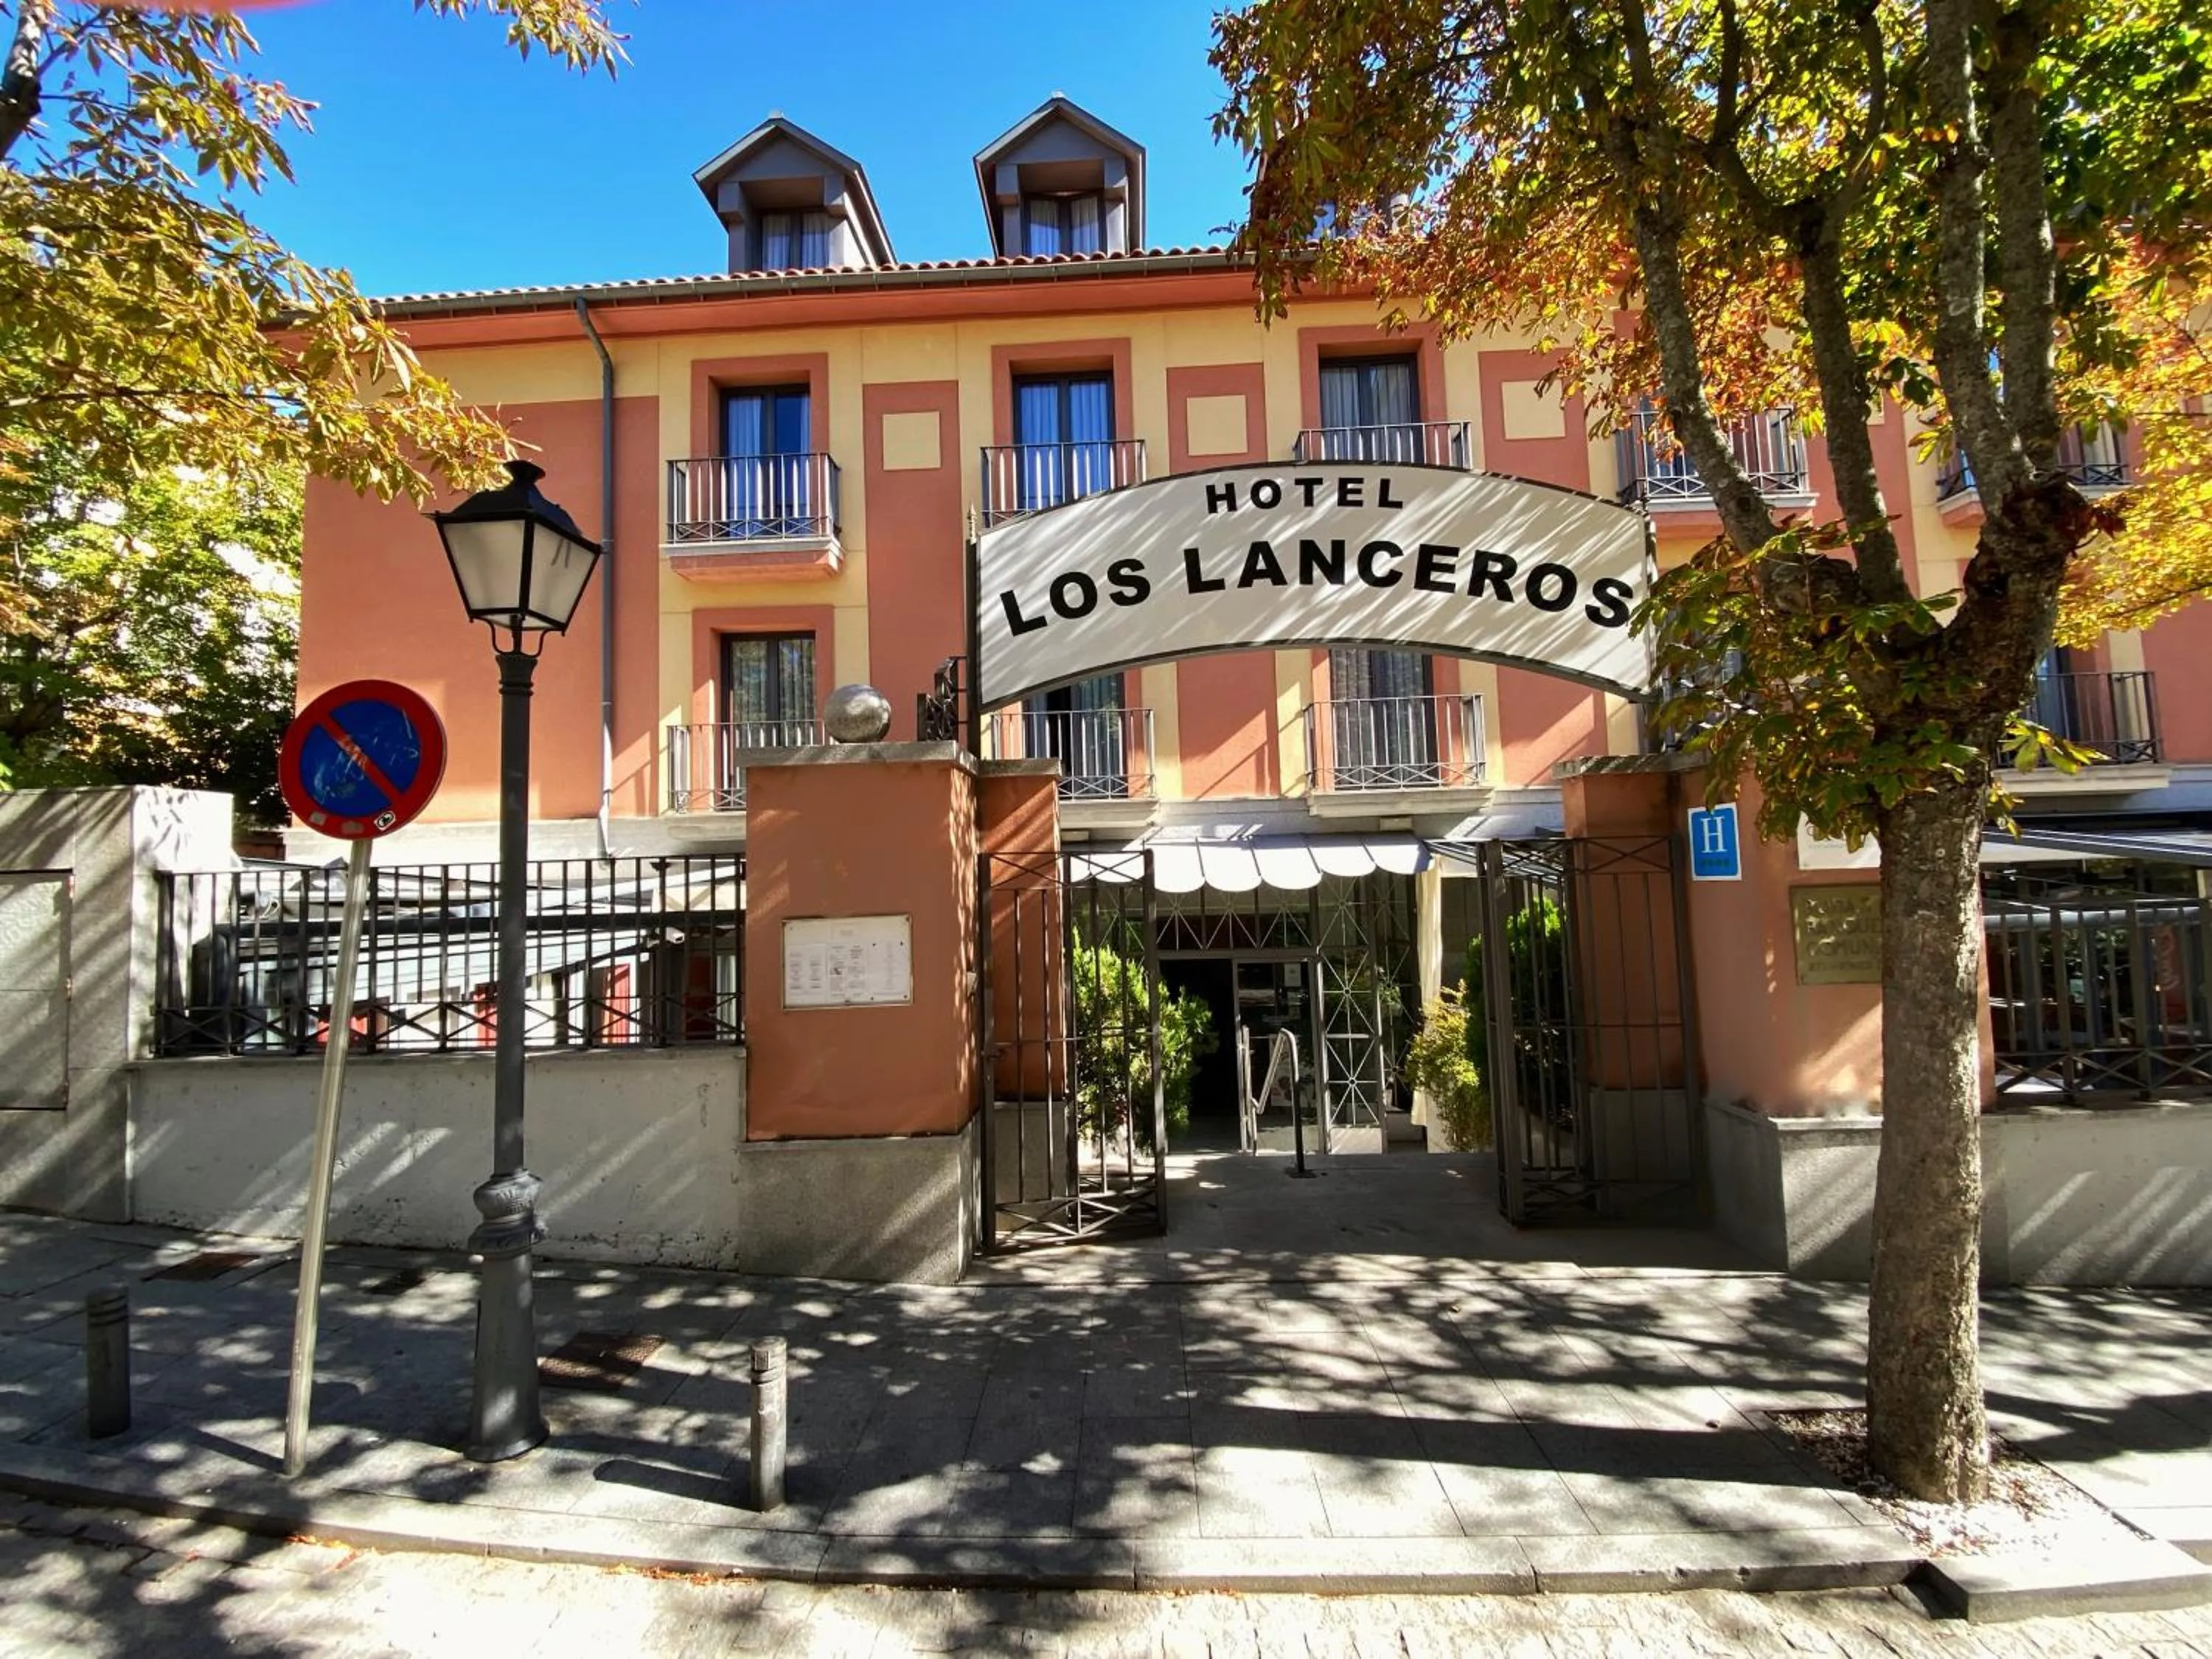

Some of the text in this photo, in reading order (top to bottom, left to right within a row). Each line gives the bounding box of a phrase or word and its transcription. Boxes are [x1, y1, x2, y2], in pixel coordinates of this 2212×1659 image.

[1206, 477, 1404, 514] HOTEL
[1000, 539, 1633, 636] LOS LANCEROS
[1700, 815, 1728, 853] H
